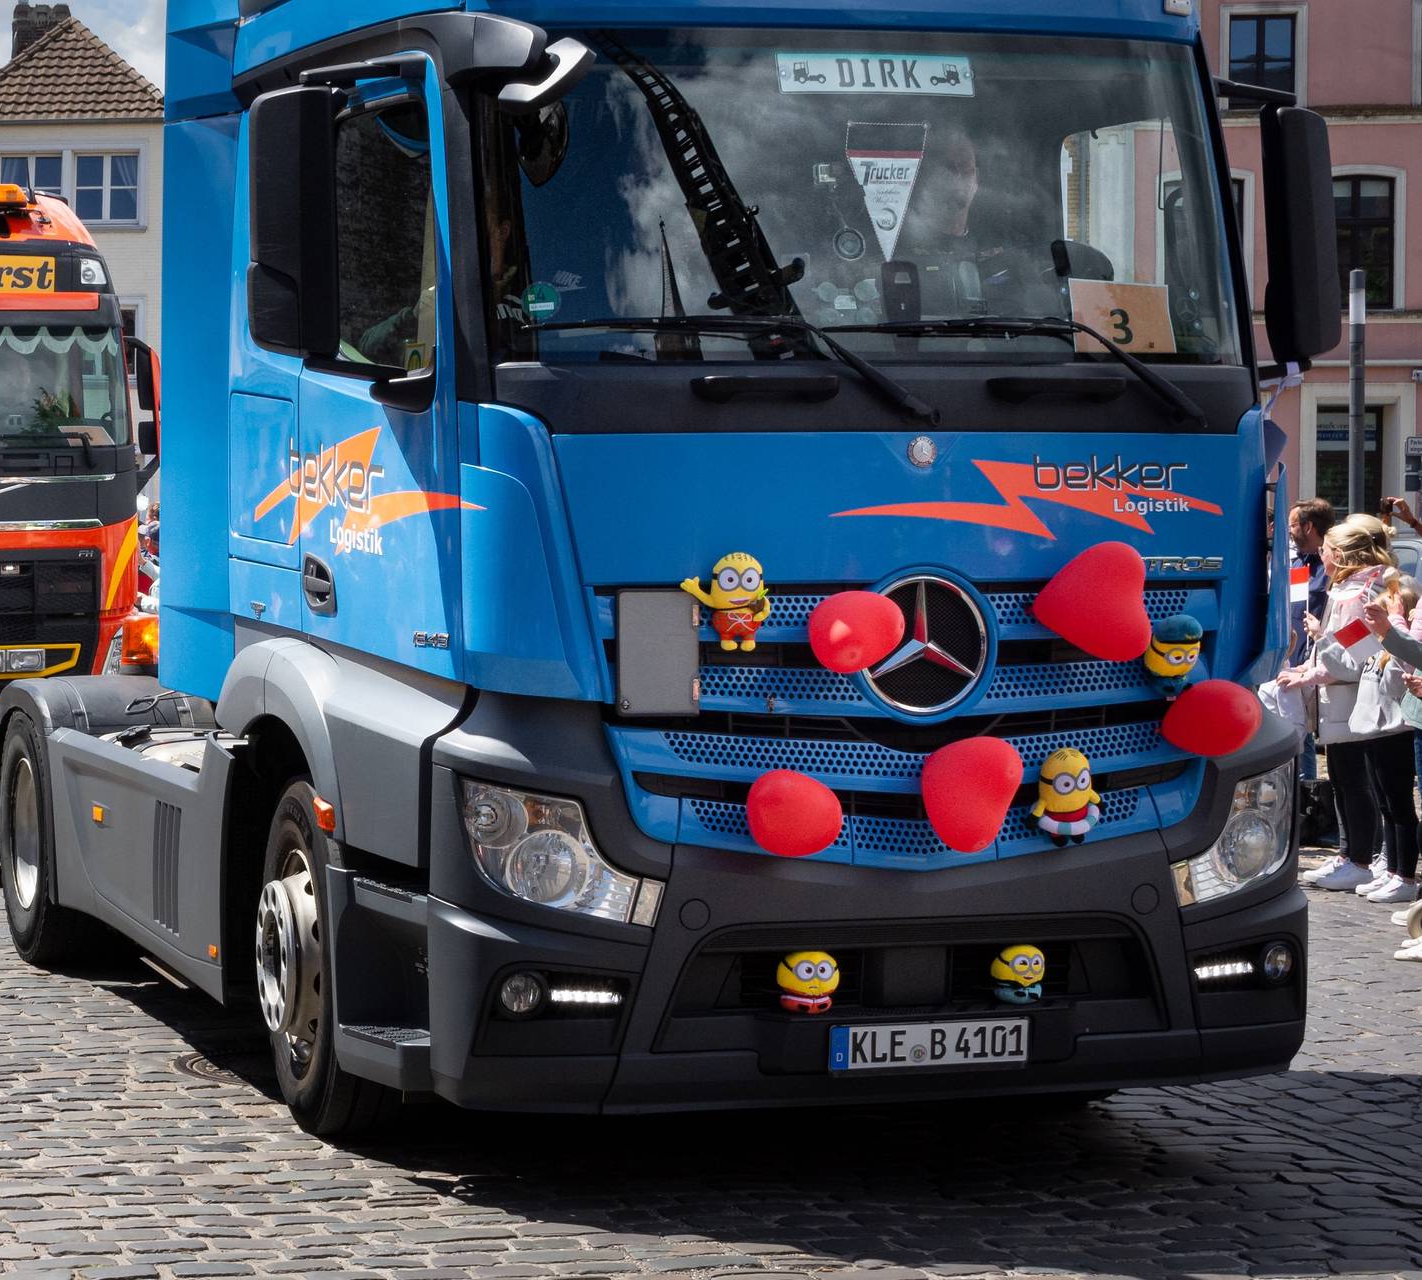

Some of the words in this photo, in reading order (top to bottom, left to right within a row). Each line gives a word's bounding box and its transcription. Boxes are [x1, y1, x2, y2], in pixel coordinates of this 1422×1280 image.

[835, 58, 921, 89] DIRK
[859, 161, 910, 187] Trucker
[1110, 308, 1133, 345] 3
[289, 437, 385, 515] bekker
[1034, 454, 1188, 492] bekker
[1113, 498, 1190, 515] Logistik
[329, 519, 383, 555] Logistik
[1142, 556, 1224, 573] TROS
[835, 1052, 845, 1063] D
[851, 1030, 906, 1064] KLE
[930, 1028, 947, 1060] B
[955, 1024, 1024, 1059] 4101
